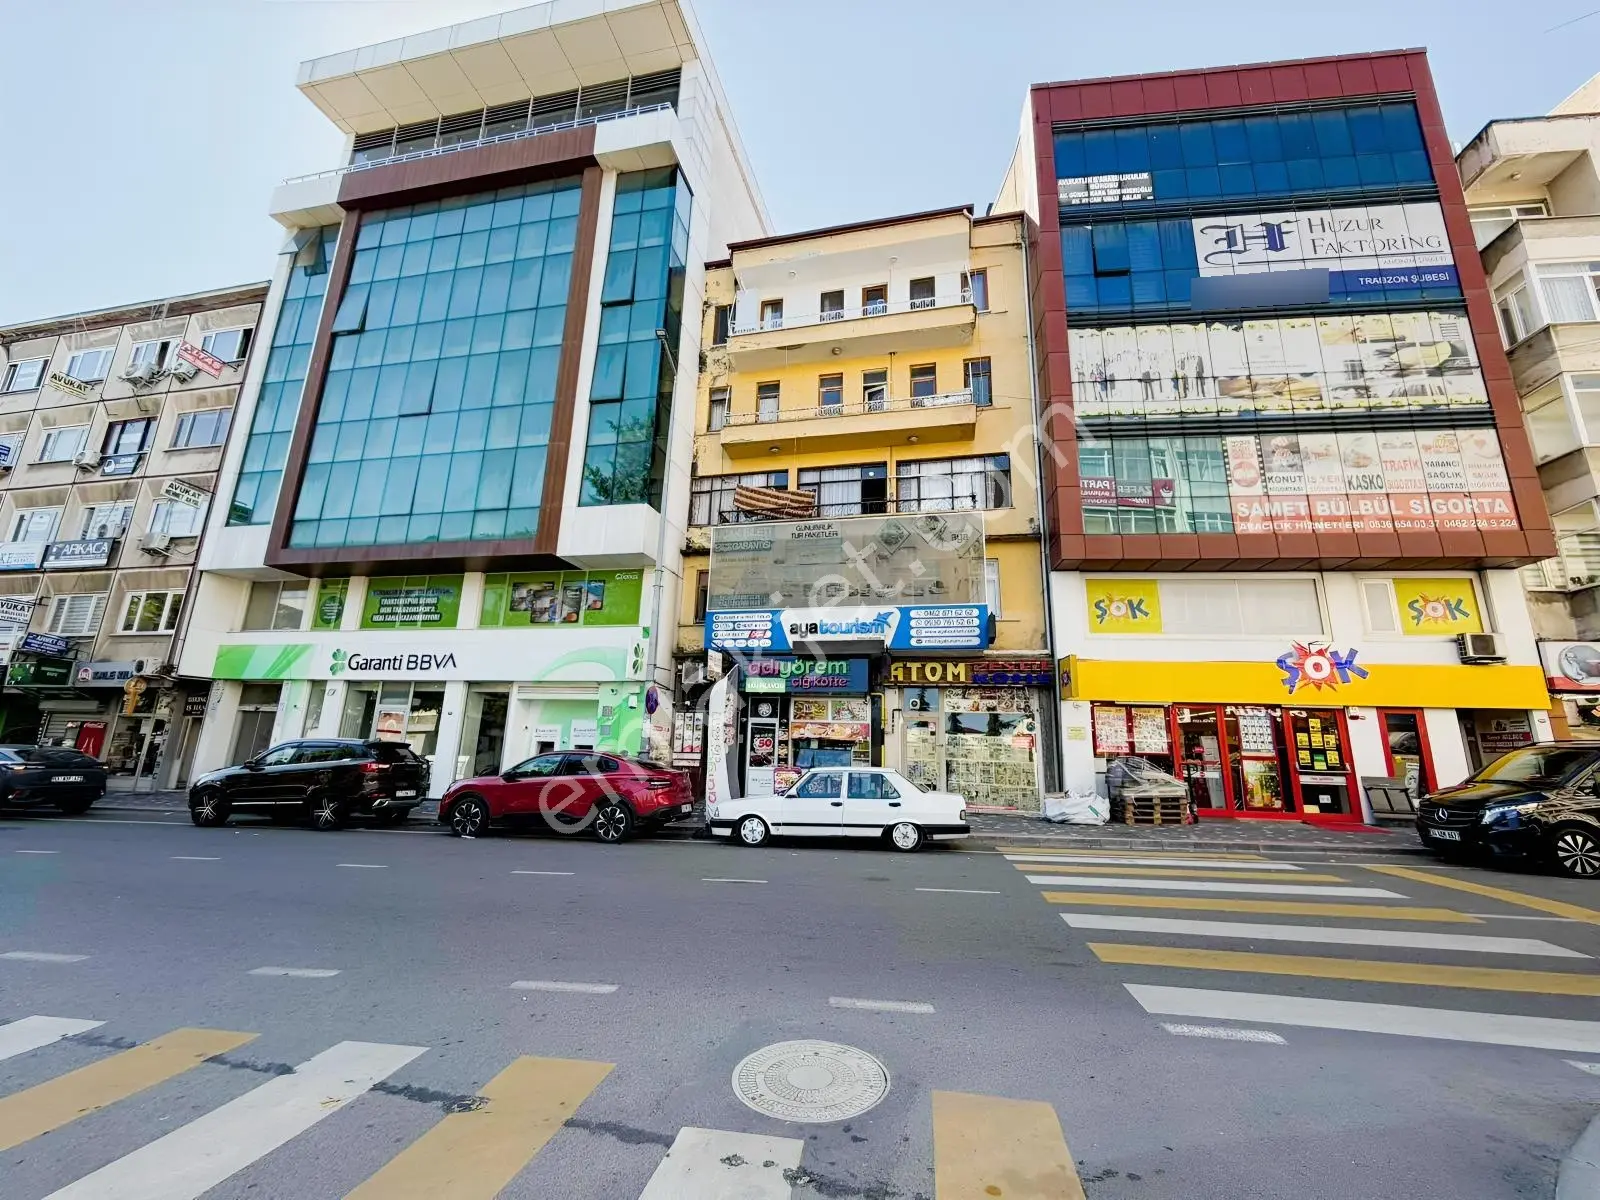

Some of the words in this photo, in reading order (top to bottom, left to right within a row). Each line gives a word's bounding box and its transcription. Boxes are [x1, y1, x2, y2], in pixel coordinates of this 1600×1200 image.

[1307, 217, 1384, 234] HUZUR
[1310, 234, 1441, 255] FAKTORİNG
[1358, 275, 1409, 286] TRABZON
[51, 372, 89, 392] AVUKAT
[1267, 475, 1304, 484] KONUT
[1347, 474, 1384, 491] KASKO
[168, 482, 202, 499] AVUKAT
[1236, 501, 1308, 517] SAMET
[1408, 495, 1511, 515] SİGORTA
[0, 602, 32, 613] VUKAT
[1094, 597, 1150, 625] ŞOK
[1407, 596, 1470, 626] ŞOK
[348, 653, 404, 671] Garanti
[406, 653, 457, 670] BBVA
[1276, 645, 1369, 695] ŞOK
[890, 662, 966, 682] ATOM
